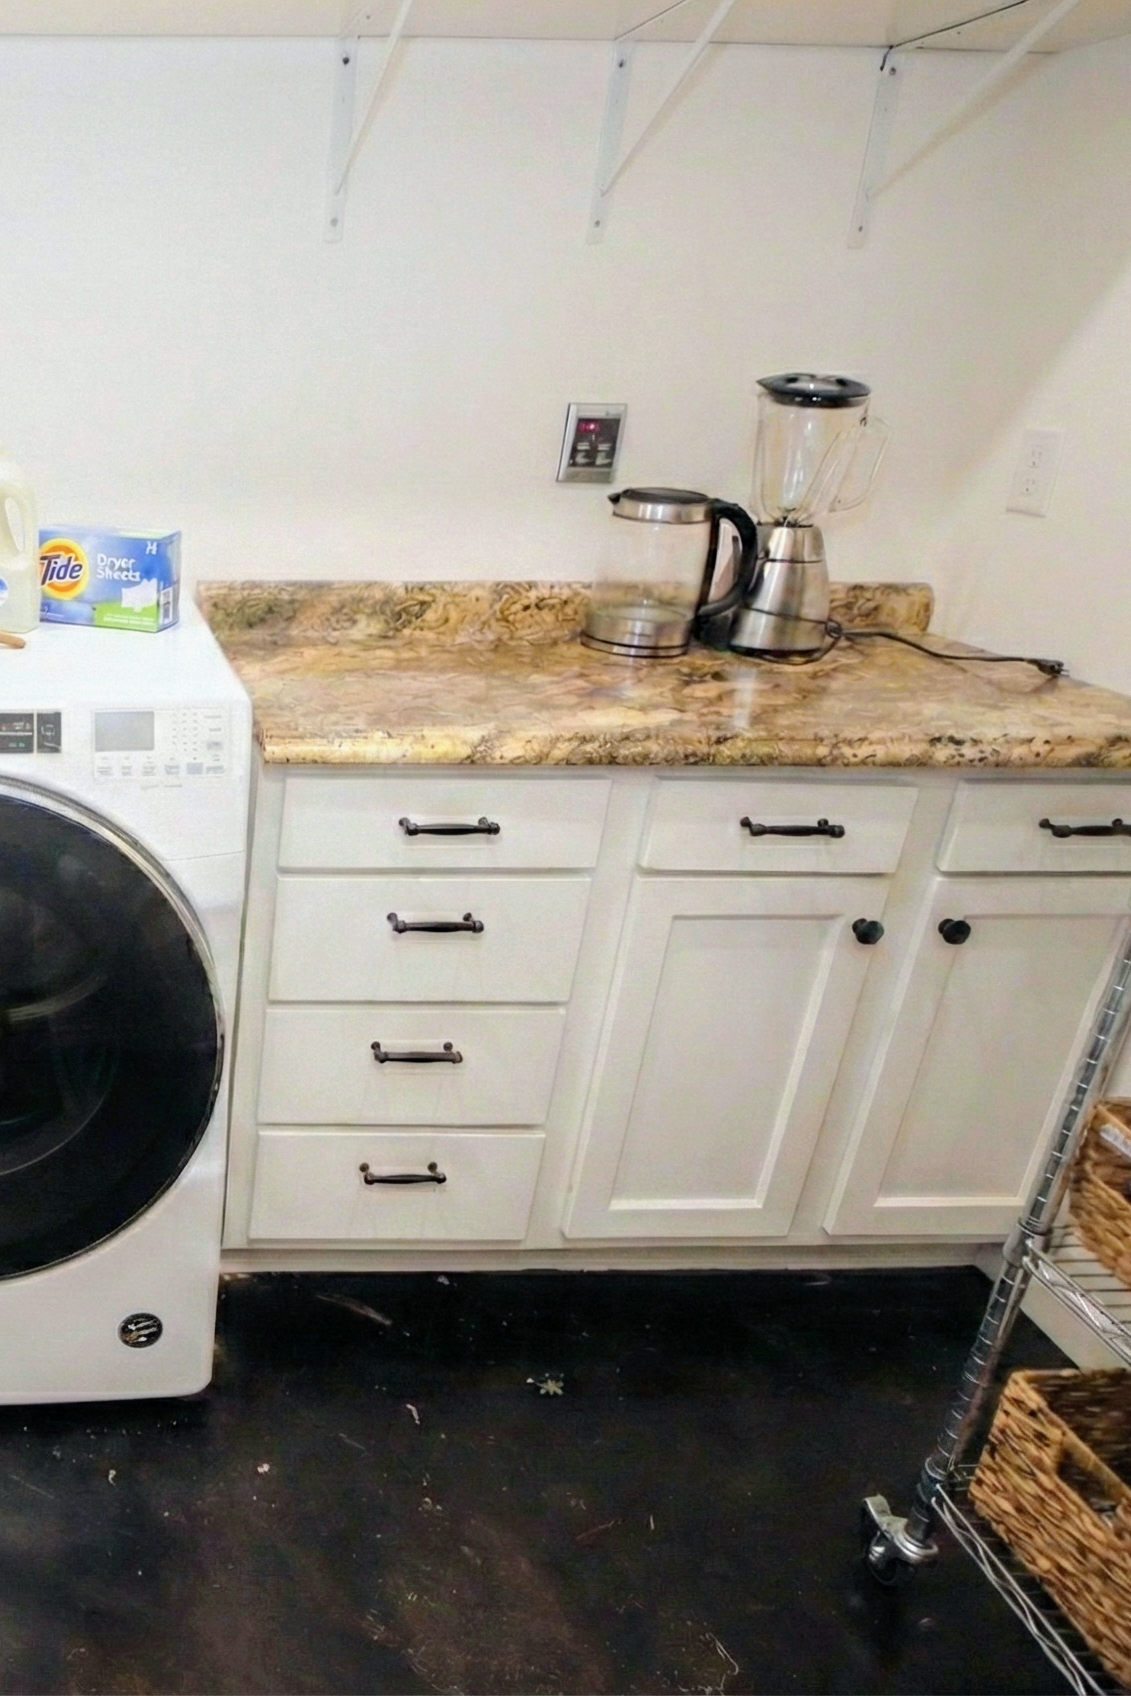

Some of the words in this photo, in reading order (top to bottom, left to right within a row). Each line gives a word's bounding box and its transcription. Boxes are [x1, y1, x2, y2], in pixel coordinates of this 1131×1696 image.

[97, 553, 136, 569] Dryer
[40, 554, 83, 586] Tide
[96, 566, 141, 581] Sheets
